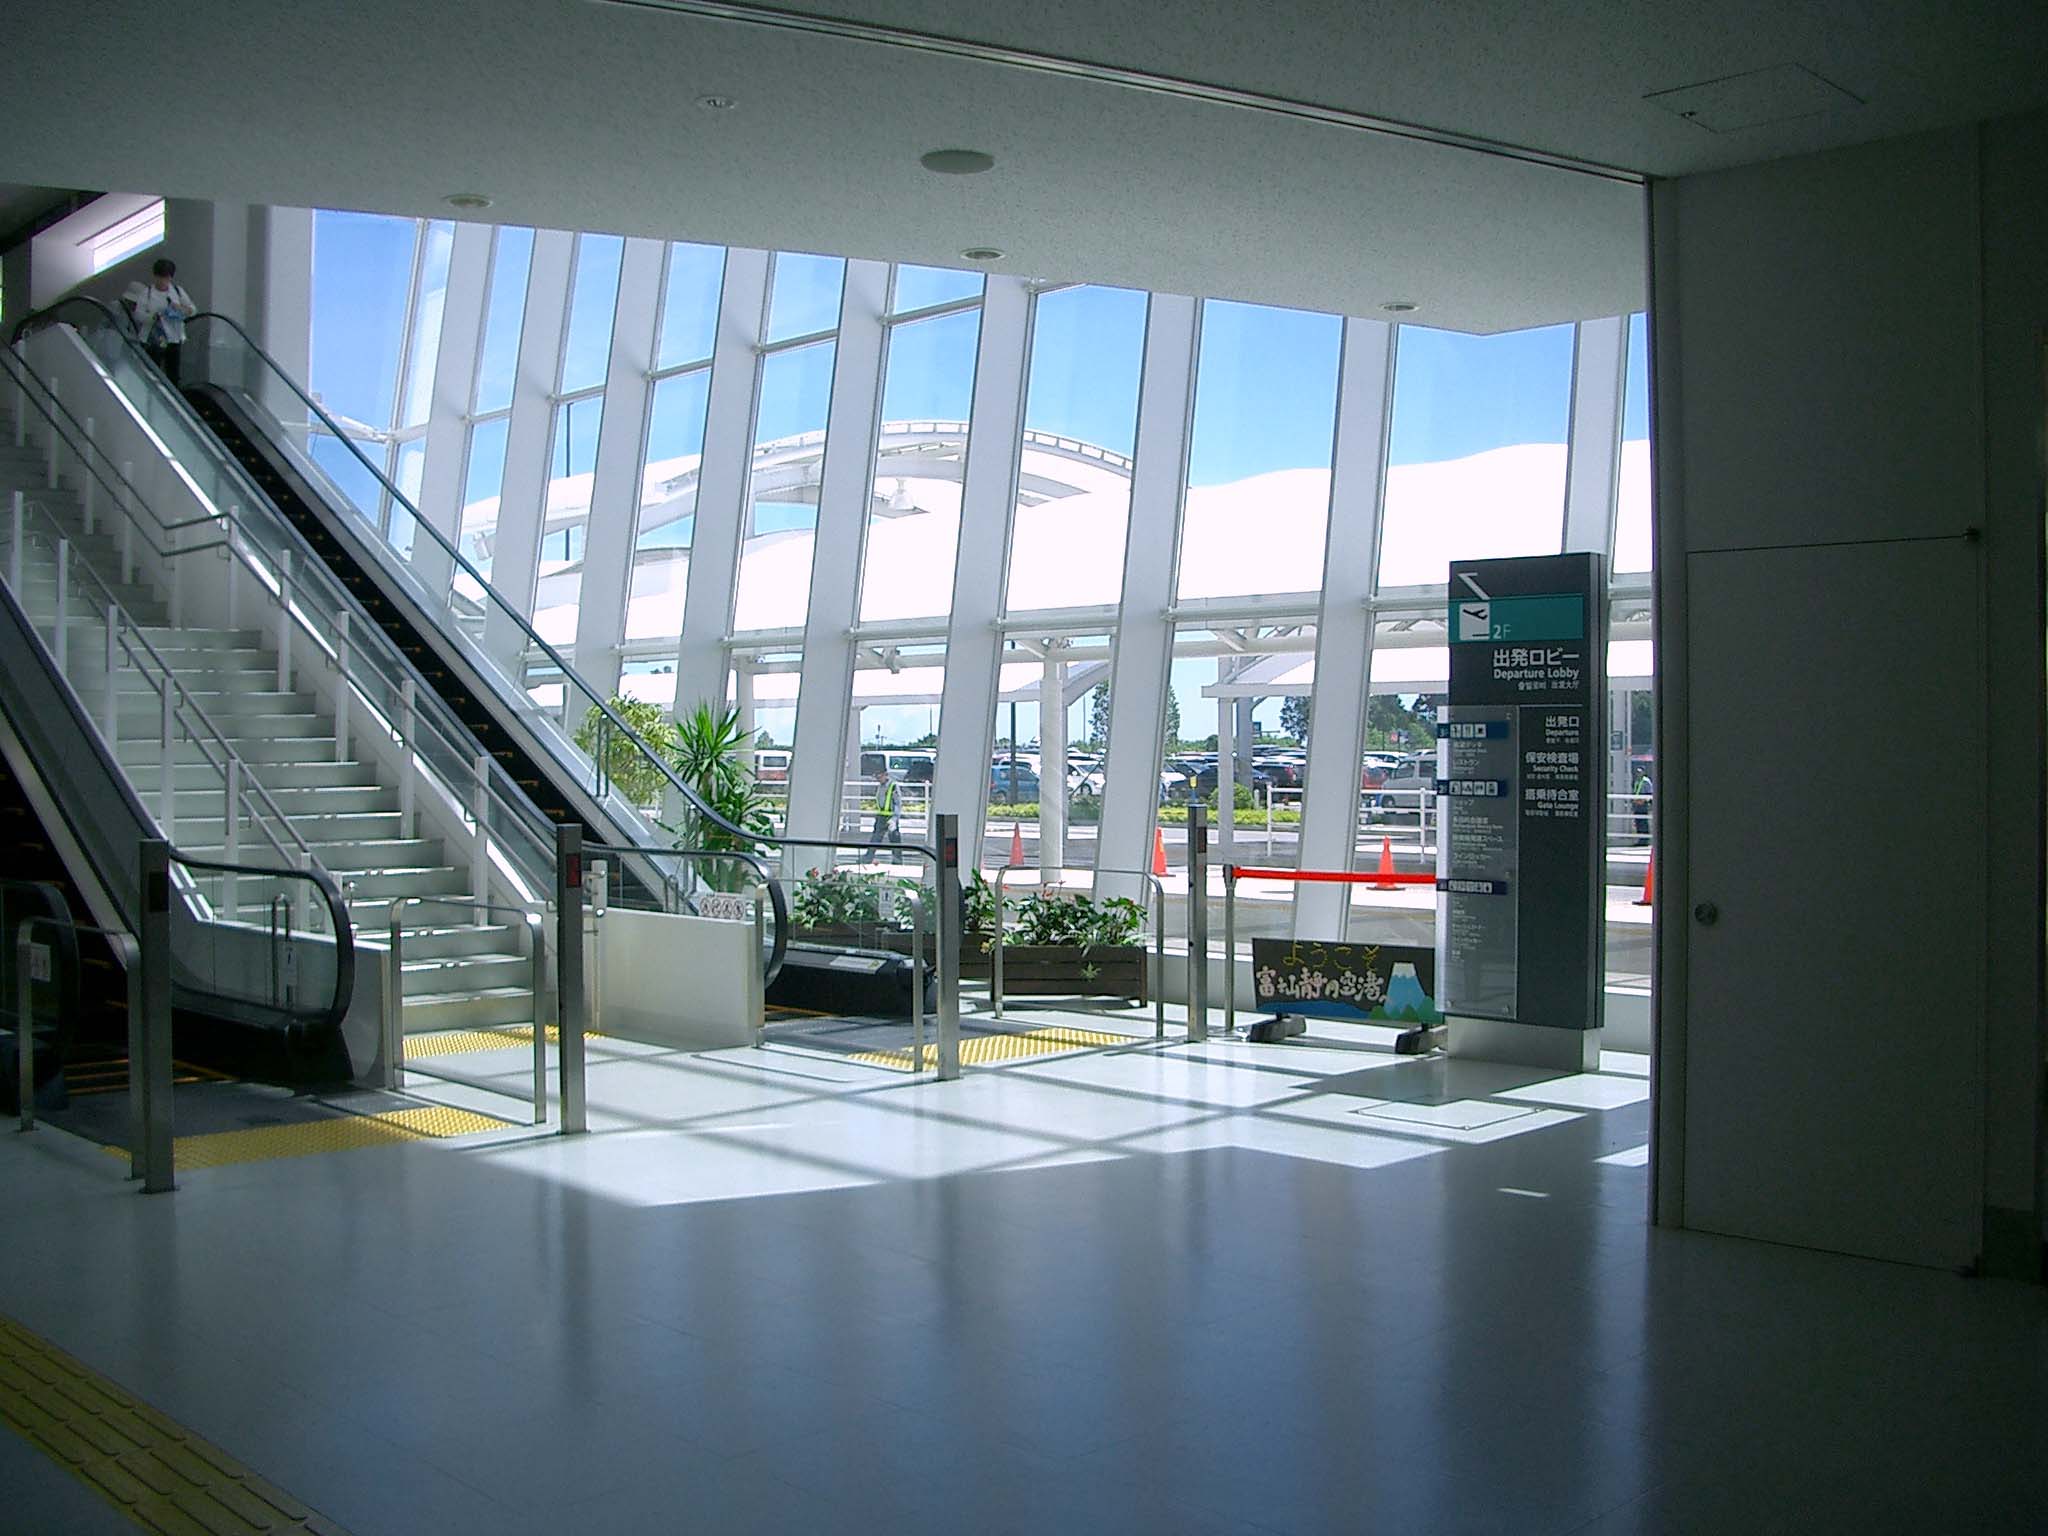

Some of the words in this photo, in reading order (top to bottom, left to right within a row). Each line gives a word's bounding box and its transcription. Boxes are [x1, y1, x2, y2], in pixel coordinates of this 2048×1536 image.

[1493, 623, 1512, 640] 2F
[1493, 646, 1580, 667] 出発ロビー
[1493, 668, 1545, 681] Departure
[1547, 666, 1580, 680] Lobby
[1545, 715, 1580, 728] 出発口
[1526, 751, 1579, 764] 保安検査場
[1532, 764, 1558, 774] Security
[1559, 764, 1579, 773] Check
[1525, 788, 1579, 801] 搭乗待合室
[1537, 801, 1553, 809] Gate
[1554, 801, 1579, 811] Lounge
[1282, 939, 1380, 973] ようこそ
